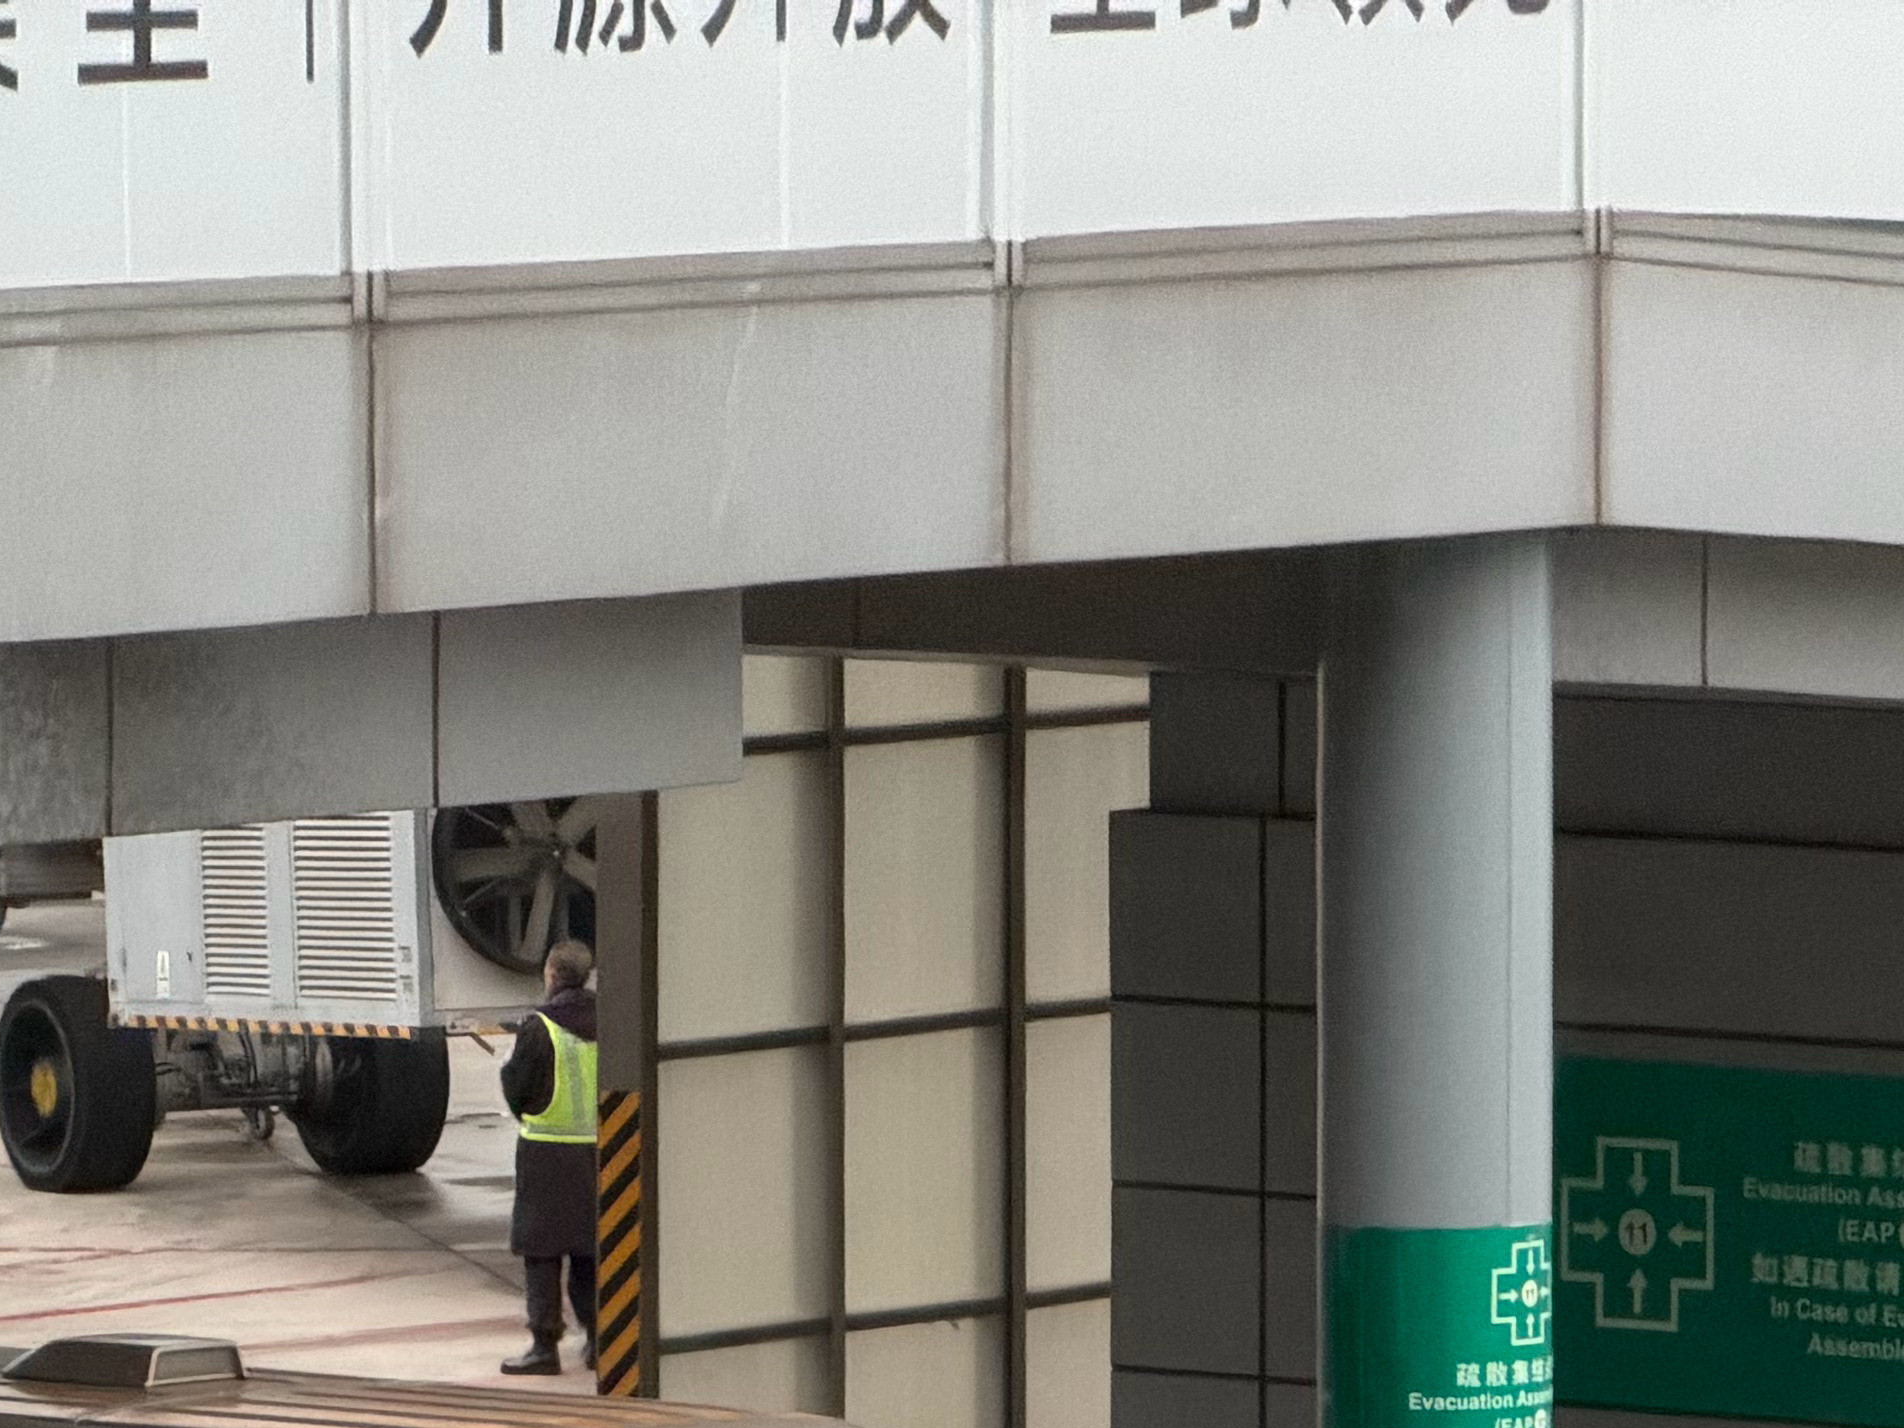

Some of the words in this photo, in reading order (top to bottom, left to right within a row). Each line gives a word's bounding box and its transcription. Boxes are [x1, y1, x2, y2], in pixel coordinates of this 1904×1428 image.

[1742, 1176, 1862, 1206] Evacuation
[1624, 1219, 1649, 1248] 11
[1769, 1295, 1790, 1319] In
[1795, 1297, 1849, 1326] Case
[1853, 1302, 1877, 1326] of
[1408, 1391, 1514, 1412] Evacuation
